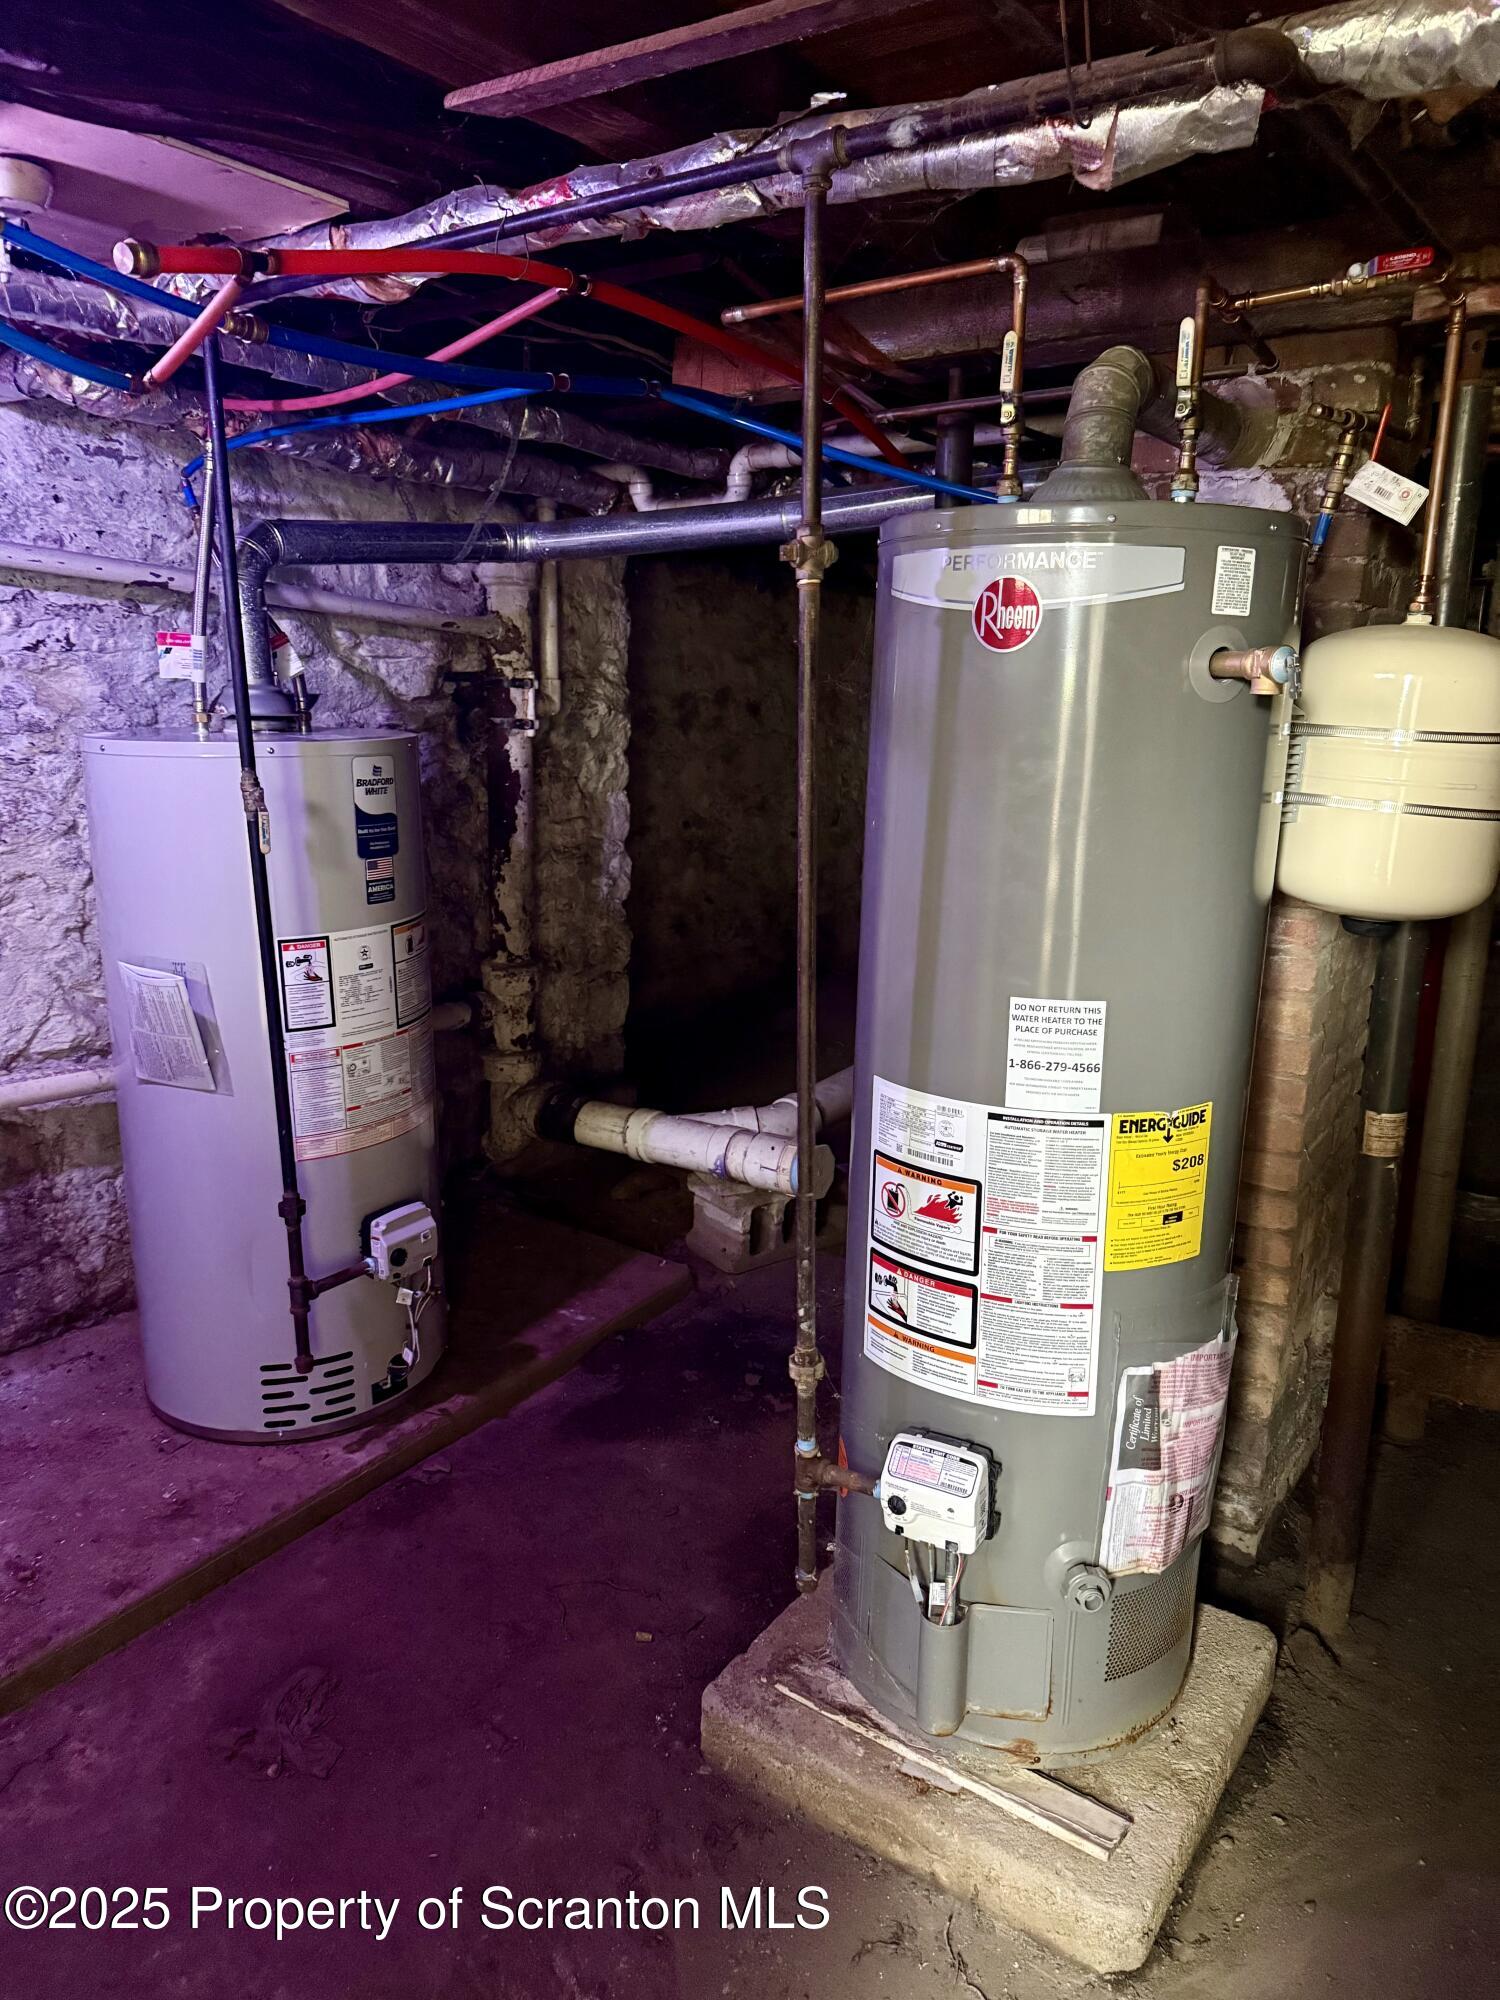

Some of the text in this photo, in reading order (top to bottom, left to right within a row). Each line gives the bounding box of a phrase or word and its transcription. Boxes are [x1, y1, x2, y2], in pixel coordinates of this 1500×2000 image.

[980, 579, 1037, 639] Rheem
[356, 777, 394, 787] BRADFORD
[365, 787, 389, 795] WHITE
[1029, 1004, 1046, 1012] NOT
[1048, 1006, 1081, 1014] RETURN
[1012, 1014, 1039, 1023] WATER
[1042, 1016, 1072, 1024] HEATER
[1074, 1017, 1085, 1025] TO
[1016, 1025, 1039, 1033] PLACE
[1055, 1028, 1098, 1036] PURCHASE
[1009, 1058, 1100, 1073] 1-866-279-4566
[1172, 1154, 1204, 1171] $208
[905, 1168, 942, 1186] WARNING
[904, 1270, 936, 1287] DANGER
[902, 1335, 935, 1352] WARNING
[1190, 1351, 1226, 1361] IMPORTANT
[1126, 1394, 1144, 1450] Certificate of
[1140, 1408, 1152, 1442] Limited
